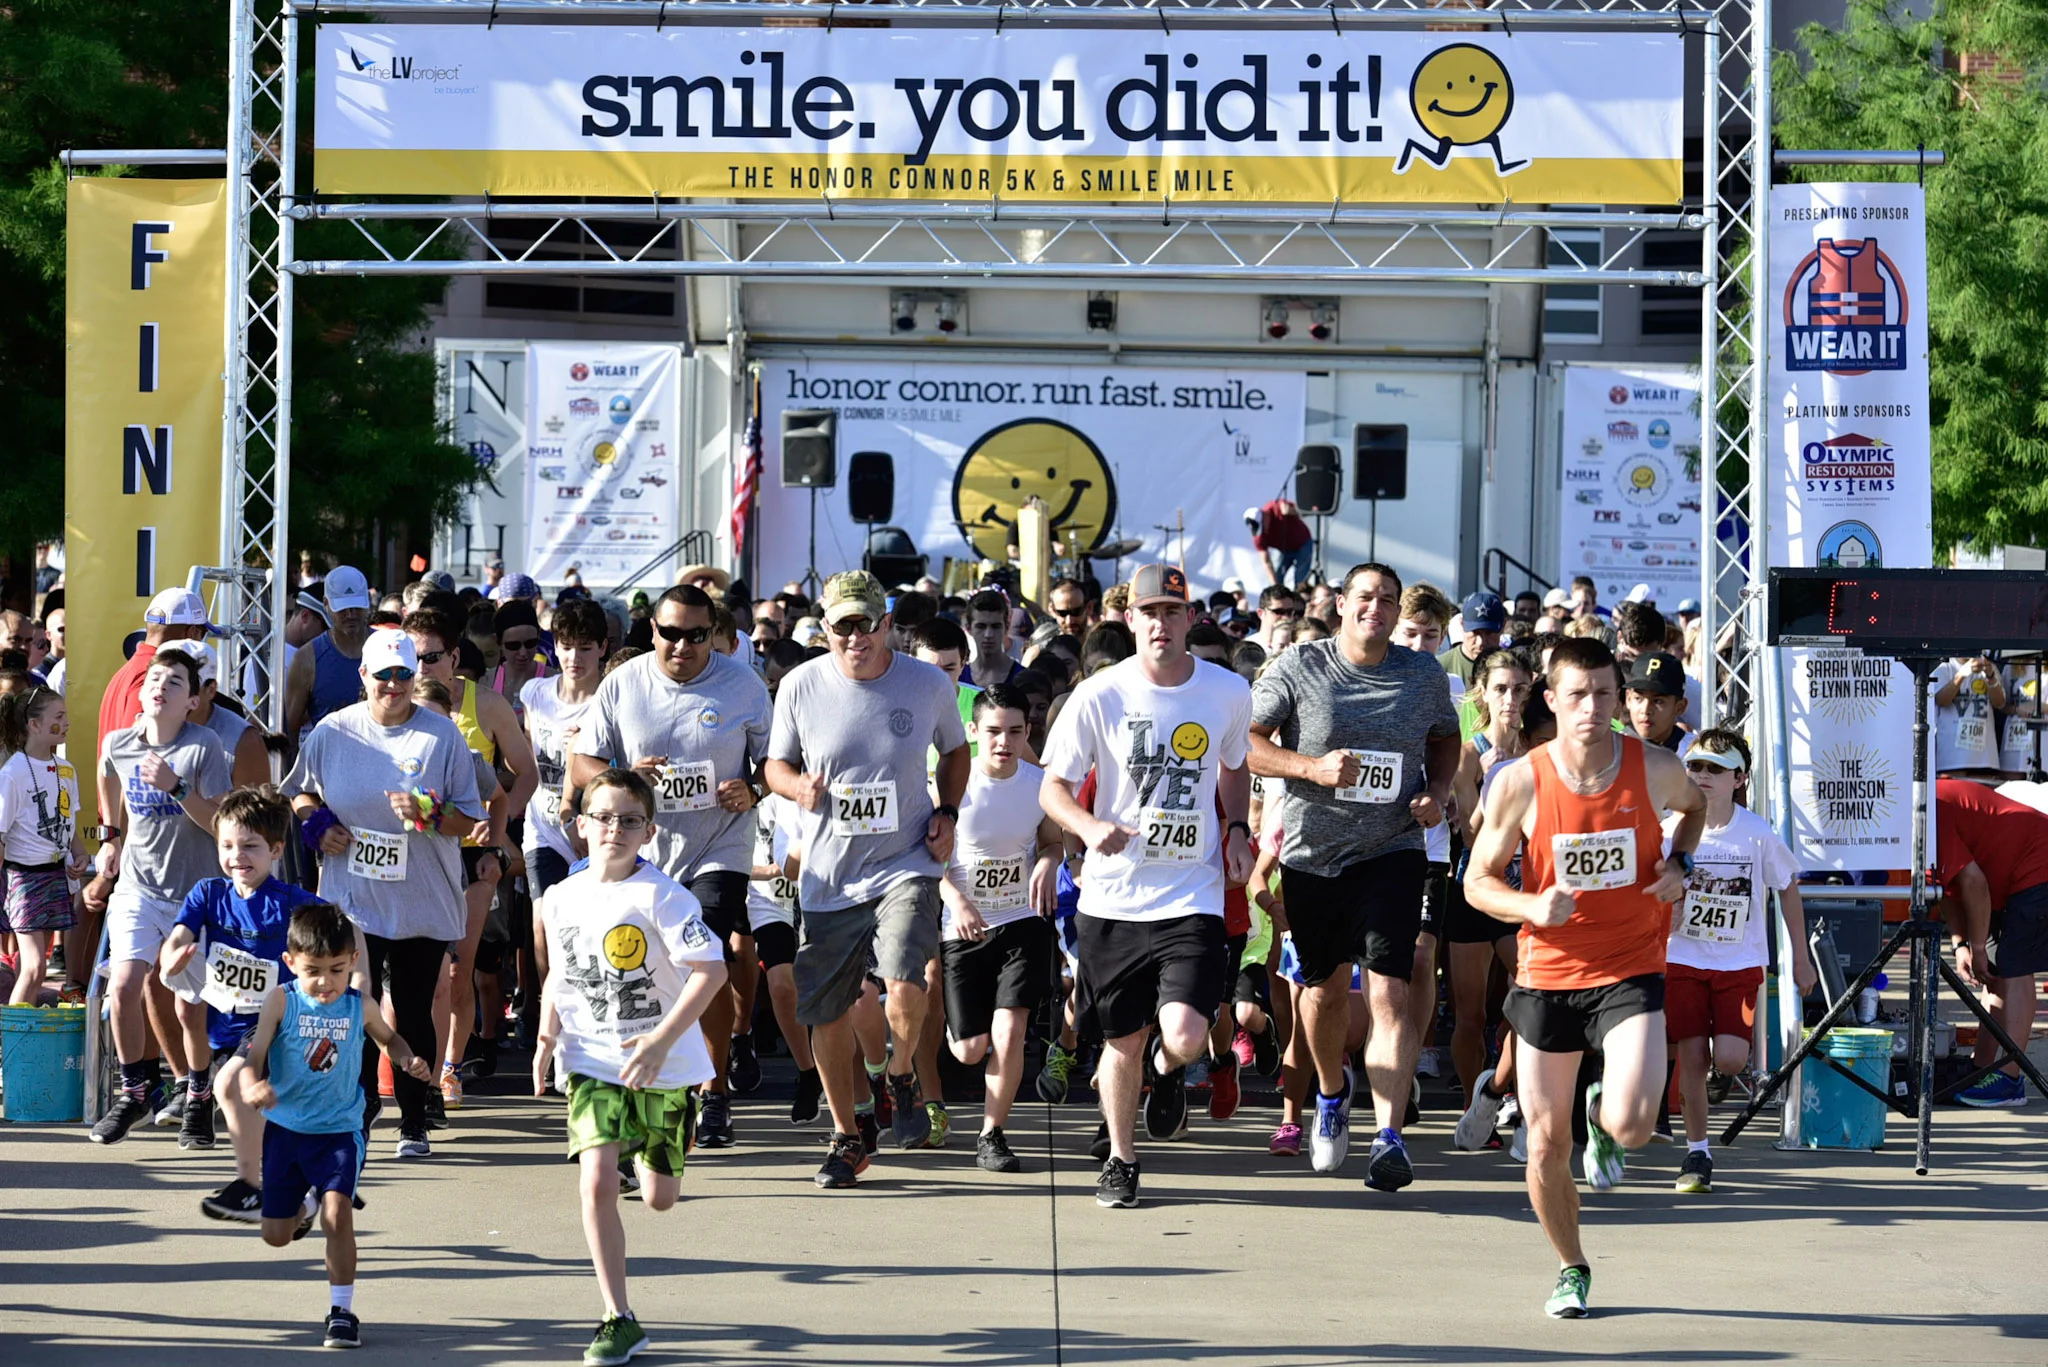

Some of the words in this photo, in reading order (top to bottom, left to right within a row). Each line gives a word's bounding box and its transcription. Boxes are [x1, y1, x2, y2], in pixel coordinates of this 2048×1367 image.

[581, 50, 875, 139] smile.
[895, 77, 1085, 166] you
[1105, 53, 1278, 142] did
[1298, 53, 1383, 142] it!
[728, 165, 774, 190] THE
[790, 166, 873, 191] HONOR
[889, 167, 991, 192] CONNOR
[1006, 167, 1036, 192] 5K
[1053, 168, 1066, 192] &
[1081, 168, 1158, 192] SMILE
[1174, 169, 1234, 193] MILE
[1784, 206, 1858, 221] PRESENTING
[1862, 207, 1909, 220] SPONSOR
[1791, 330, 1873, 360] WEAR
[1879, 330, 1901, 360] IT
[593, 365, 628, 377] WEAR
[630, 365, 640, 377] IT
[787, 368, 892, 400] honor
[898, 378, 1026, 404] connor.
[1031, 381, 1093, 405] run
[1099, 376, 1167, 408] fast.
[1173, 379, 1273, 411] smile.
[1633, 389, 1667, 401] WEAR
[1670, 389, 1680, 401] IT
[843, 407, 885, 420] CONNOR
[1788, 405, 1849, 419] PLATINUM
[1853, 404, 1911, 418] SPONSORS
[1803, 441, 1894, 464] OLYMPIC
[1807, 464, 1894, 477] RESTORATION
[1806, 478, 1895, 495] SYSTEMS
[1646, 658, 1662, 675] P
[1806, 660, 1848, 678] SARAH
[1851, 659, 1891, 677] WOOD
[1810, 680, 1819, 698] &
[1822, 680, 1851, 698] LYNN
[1854, 679, 1887, 697] FANN
[1358, 765, 1394, 790] 769
[1839, 759, 1863, 778] THE
[662, 775, 708, 800] 2026
[1818, 779, 1886, 800] ROBINSON
[839, 796, 887, 821] 2447
[1829, 800, 1874, 820] FAMILY
[1147, 823, 1197, 848] 2748
[355, 841, 399, 867] 2025
[1565, 847, 1625, 876] 2623
[975, 866, 1021, 889] 2624
[1689, 904, 1738, 929] 2451
[214, 959, 267, 992] 3205
[298, 1014, 320, 1027] GET
[321, 1017, 350, 1029] YOUR
[298, 1026, 331, 1039] GAME
[332, 1029, 347, 1041] ON
